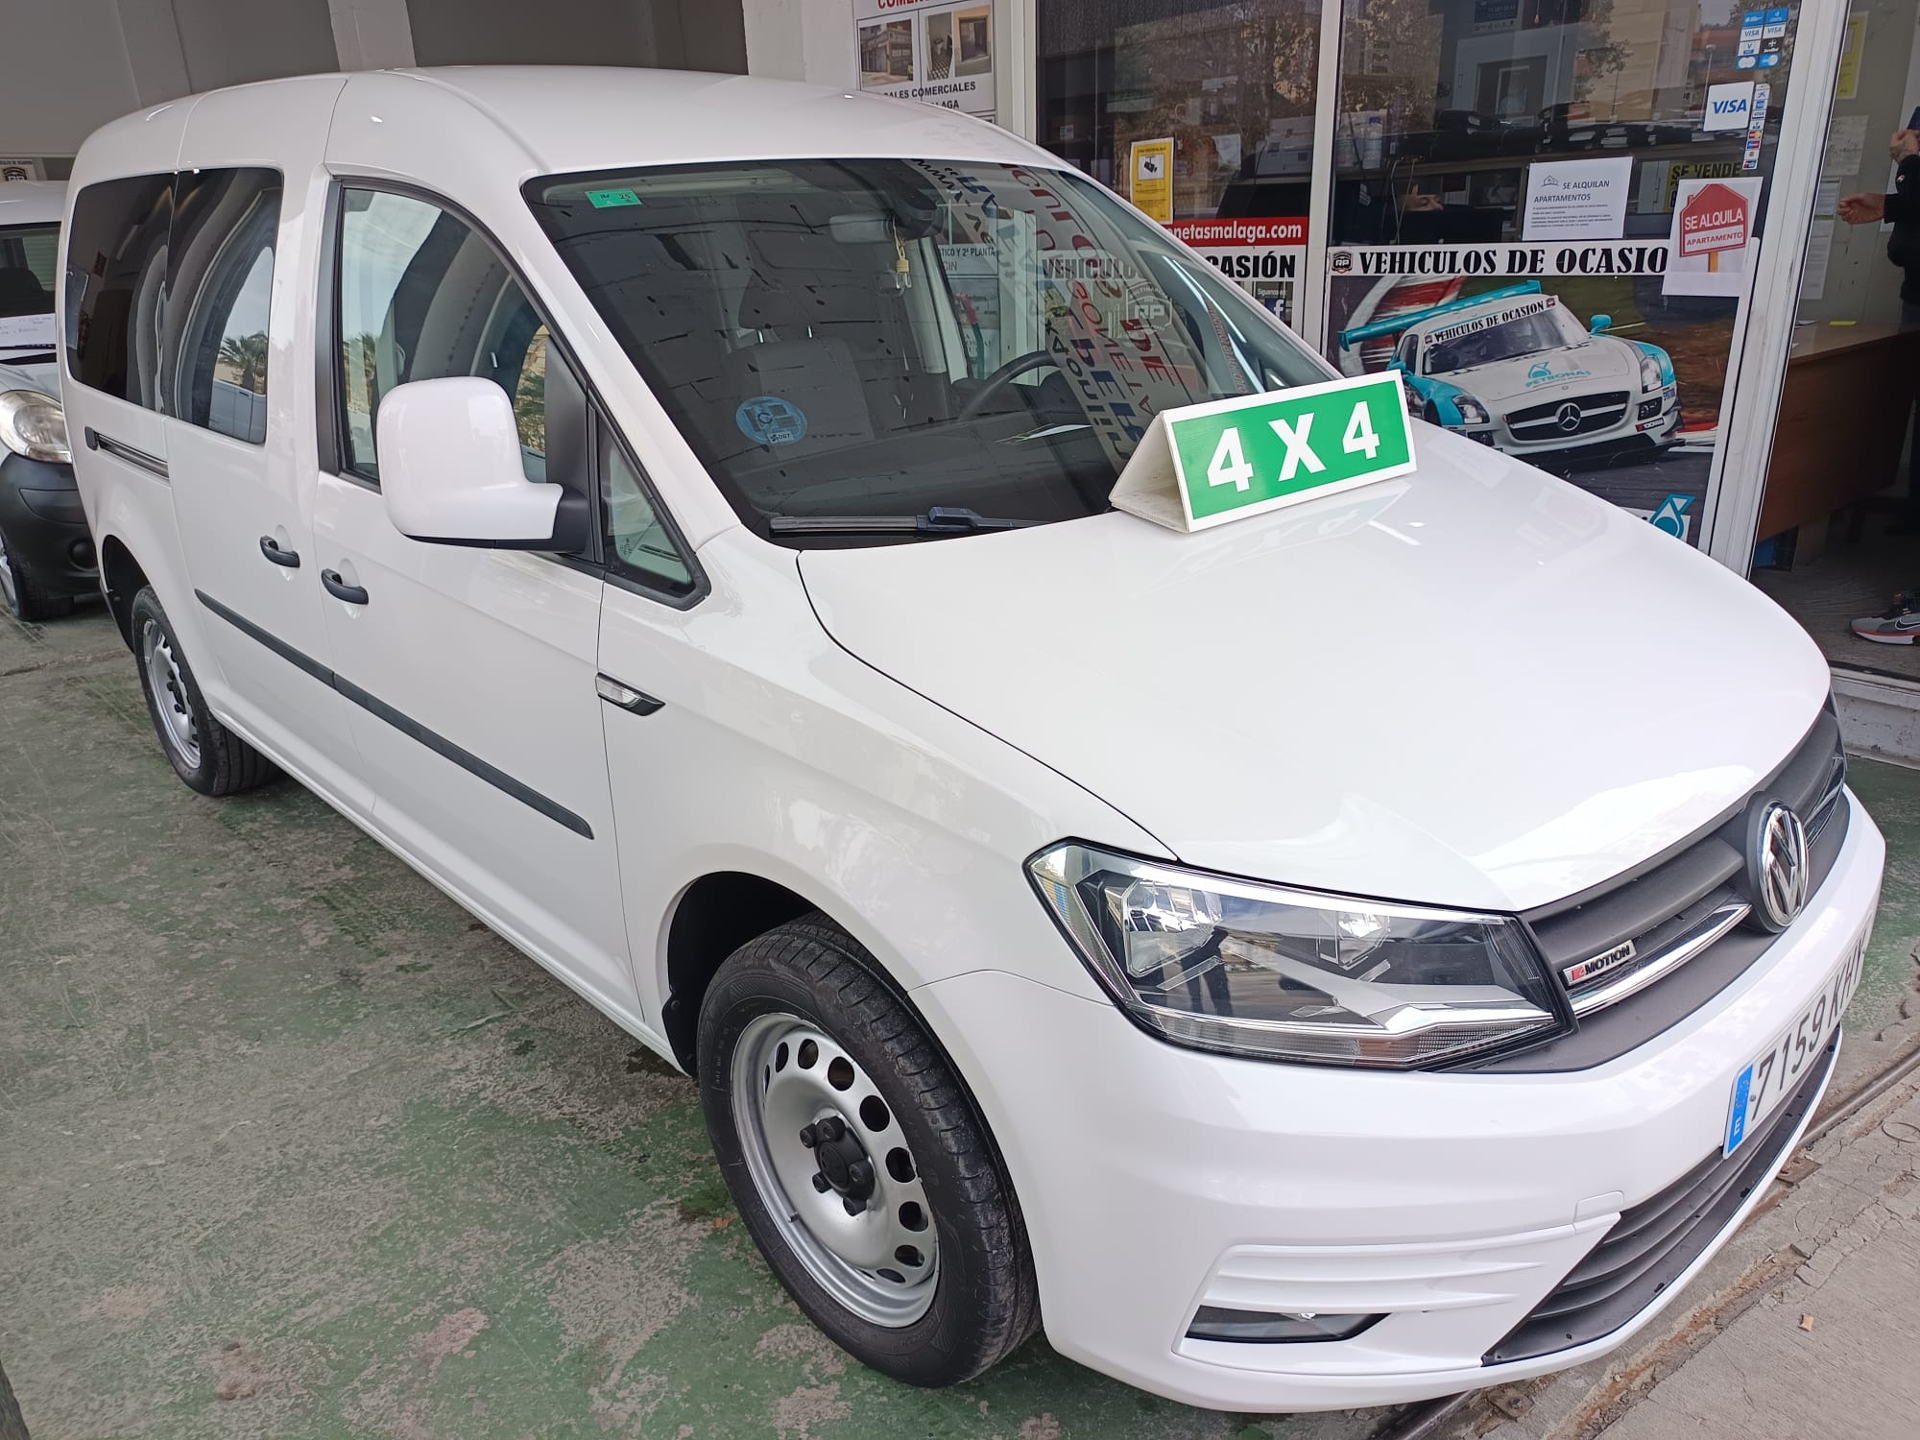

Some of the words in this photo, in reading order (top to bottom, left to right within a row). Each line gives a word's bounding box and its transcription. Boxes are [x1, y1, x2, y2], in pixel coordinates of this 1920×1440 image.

[911, 82, 976, 98] COMERCIALES
[1713, 99, 1747, 114] VISA
[1695, 162, 1740, 178] VENDE
[1562, 182, 1571, 190] SE
[1572, 180, 1610, 190] ALQUILAN
[1534, 193, 1591, 203] APARTAMENTOS
[1685, 215, 1698, 230] SE
[1699, 208, 1744, 228] ALQUILA
[1687, 231, 1743, 246] APARTAMENTO
[1042, 258, 1146, 279] VEHICULO
[1359, 250, 1497, 274] VEHICULOS
[1505, 249, 1545, 274] DE
[1555, 247, 1669, 274] OCASIO
[1434, 319, 1484, 342] VEHICULOS
[1485, 315, 1500, 328] DE
[1502, 300, 1545, 322] OCASION
[1207, 427, 1254, 492] 4
[1268, 412, 1327, 481] X
[1342, 401, 1380, 459] 4
[1752, 994, 1826, 1122] 7159
